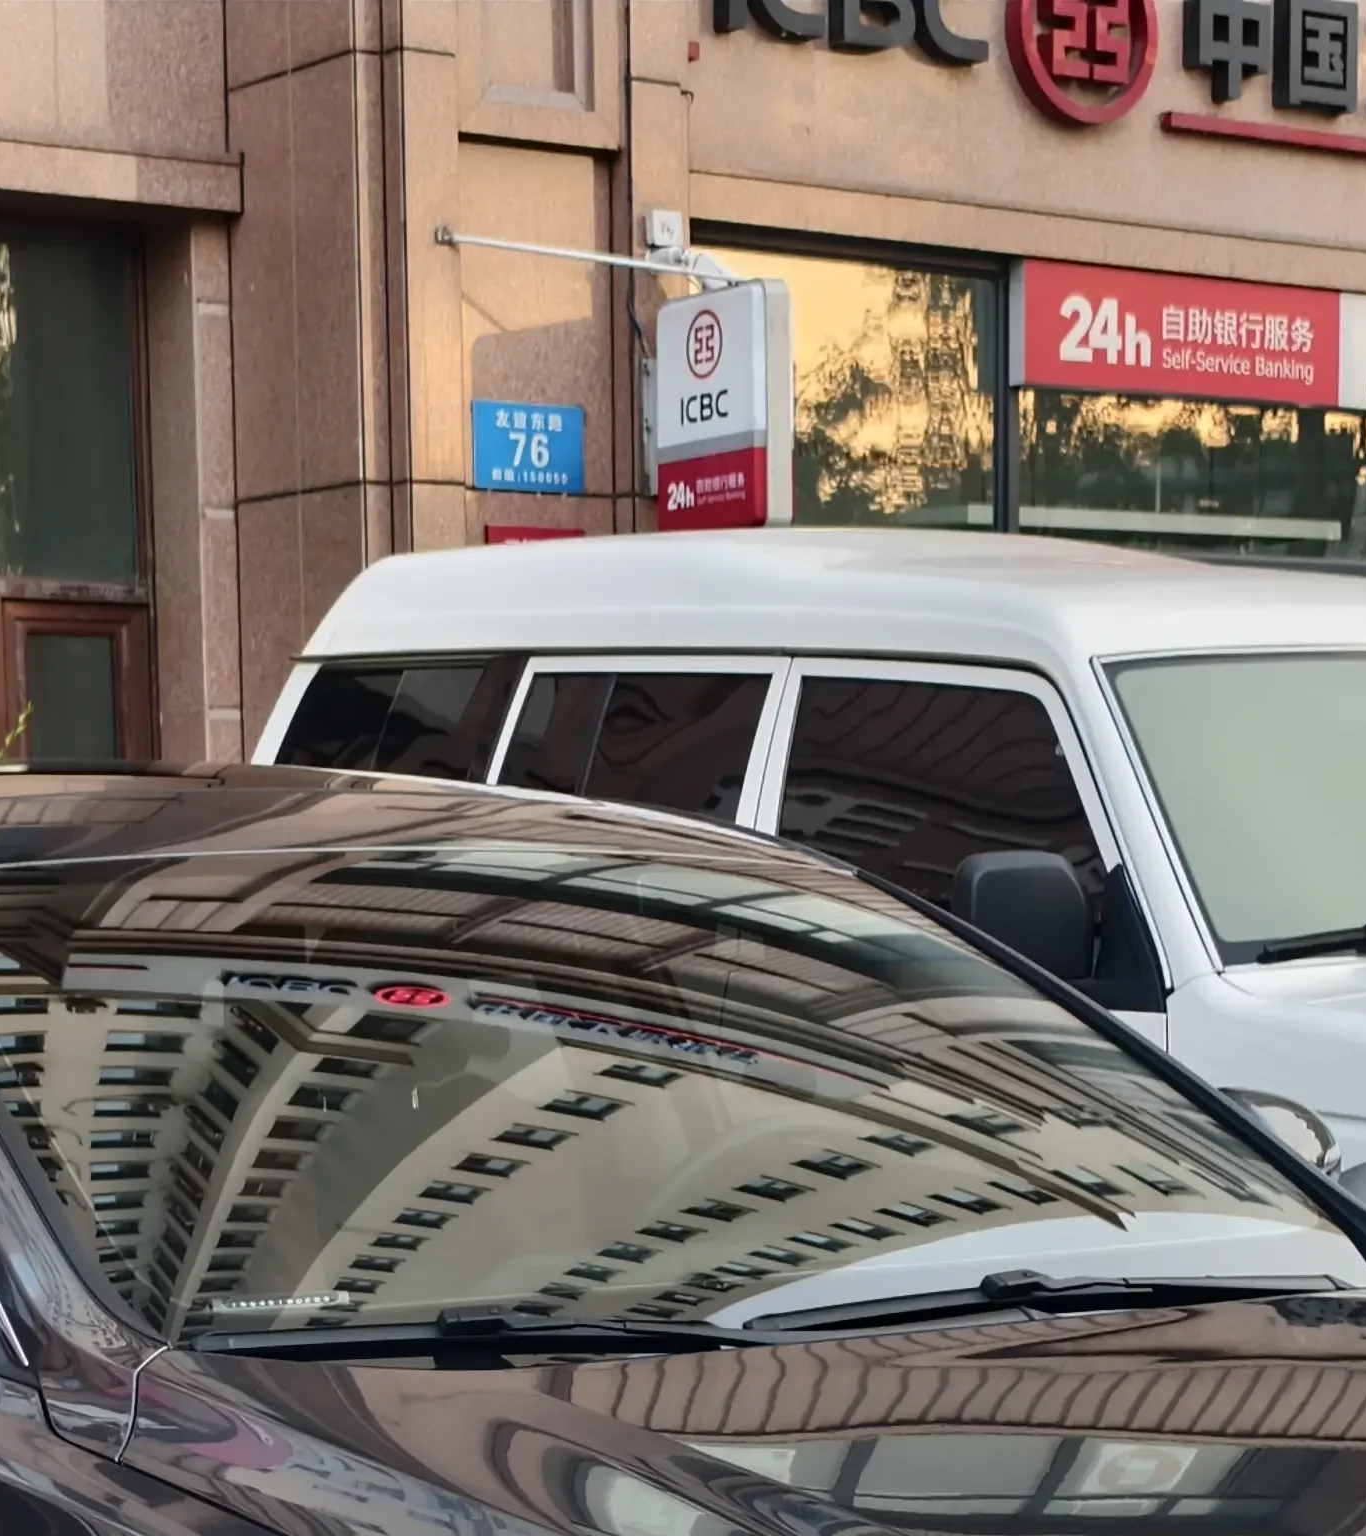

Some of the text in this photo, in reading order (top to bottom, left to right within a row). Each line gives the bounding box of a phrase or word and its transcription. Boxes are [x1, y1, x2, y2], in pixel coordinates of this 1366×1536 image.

[1059, 292, 1152, 368] 24h
[1162, 303, 1314, 354] 自助银行服务
[1162, 349, 1314, 386] Self-Service Banking
[680, 388, 729, 427] ICBC
[508, 431, 550, 468] 76
[667, 481, 695, 512] 24h
